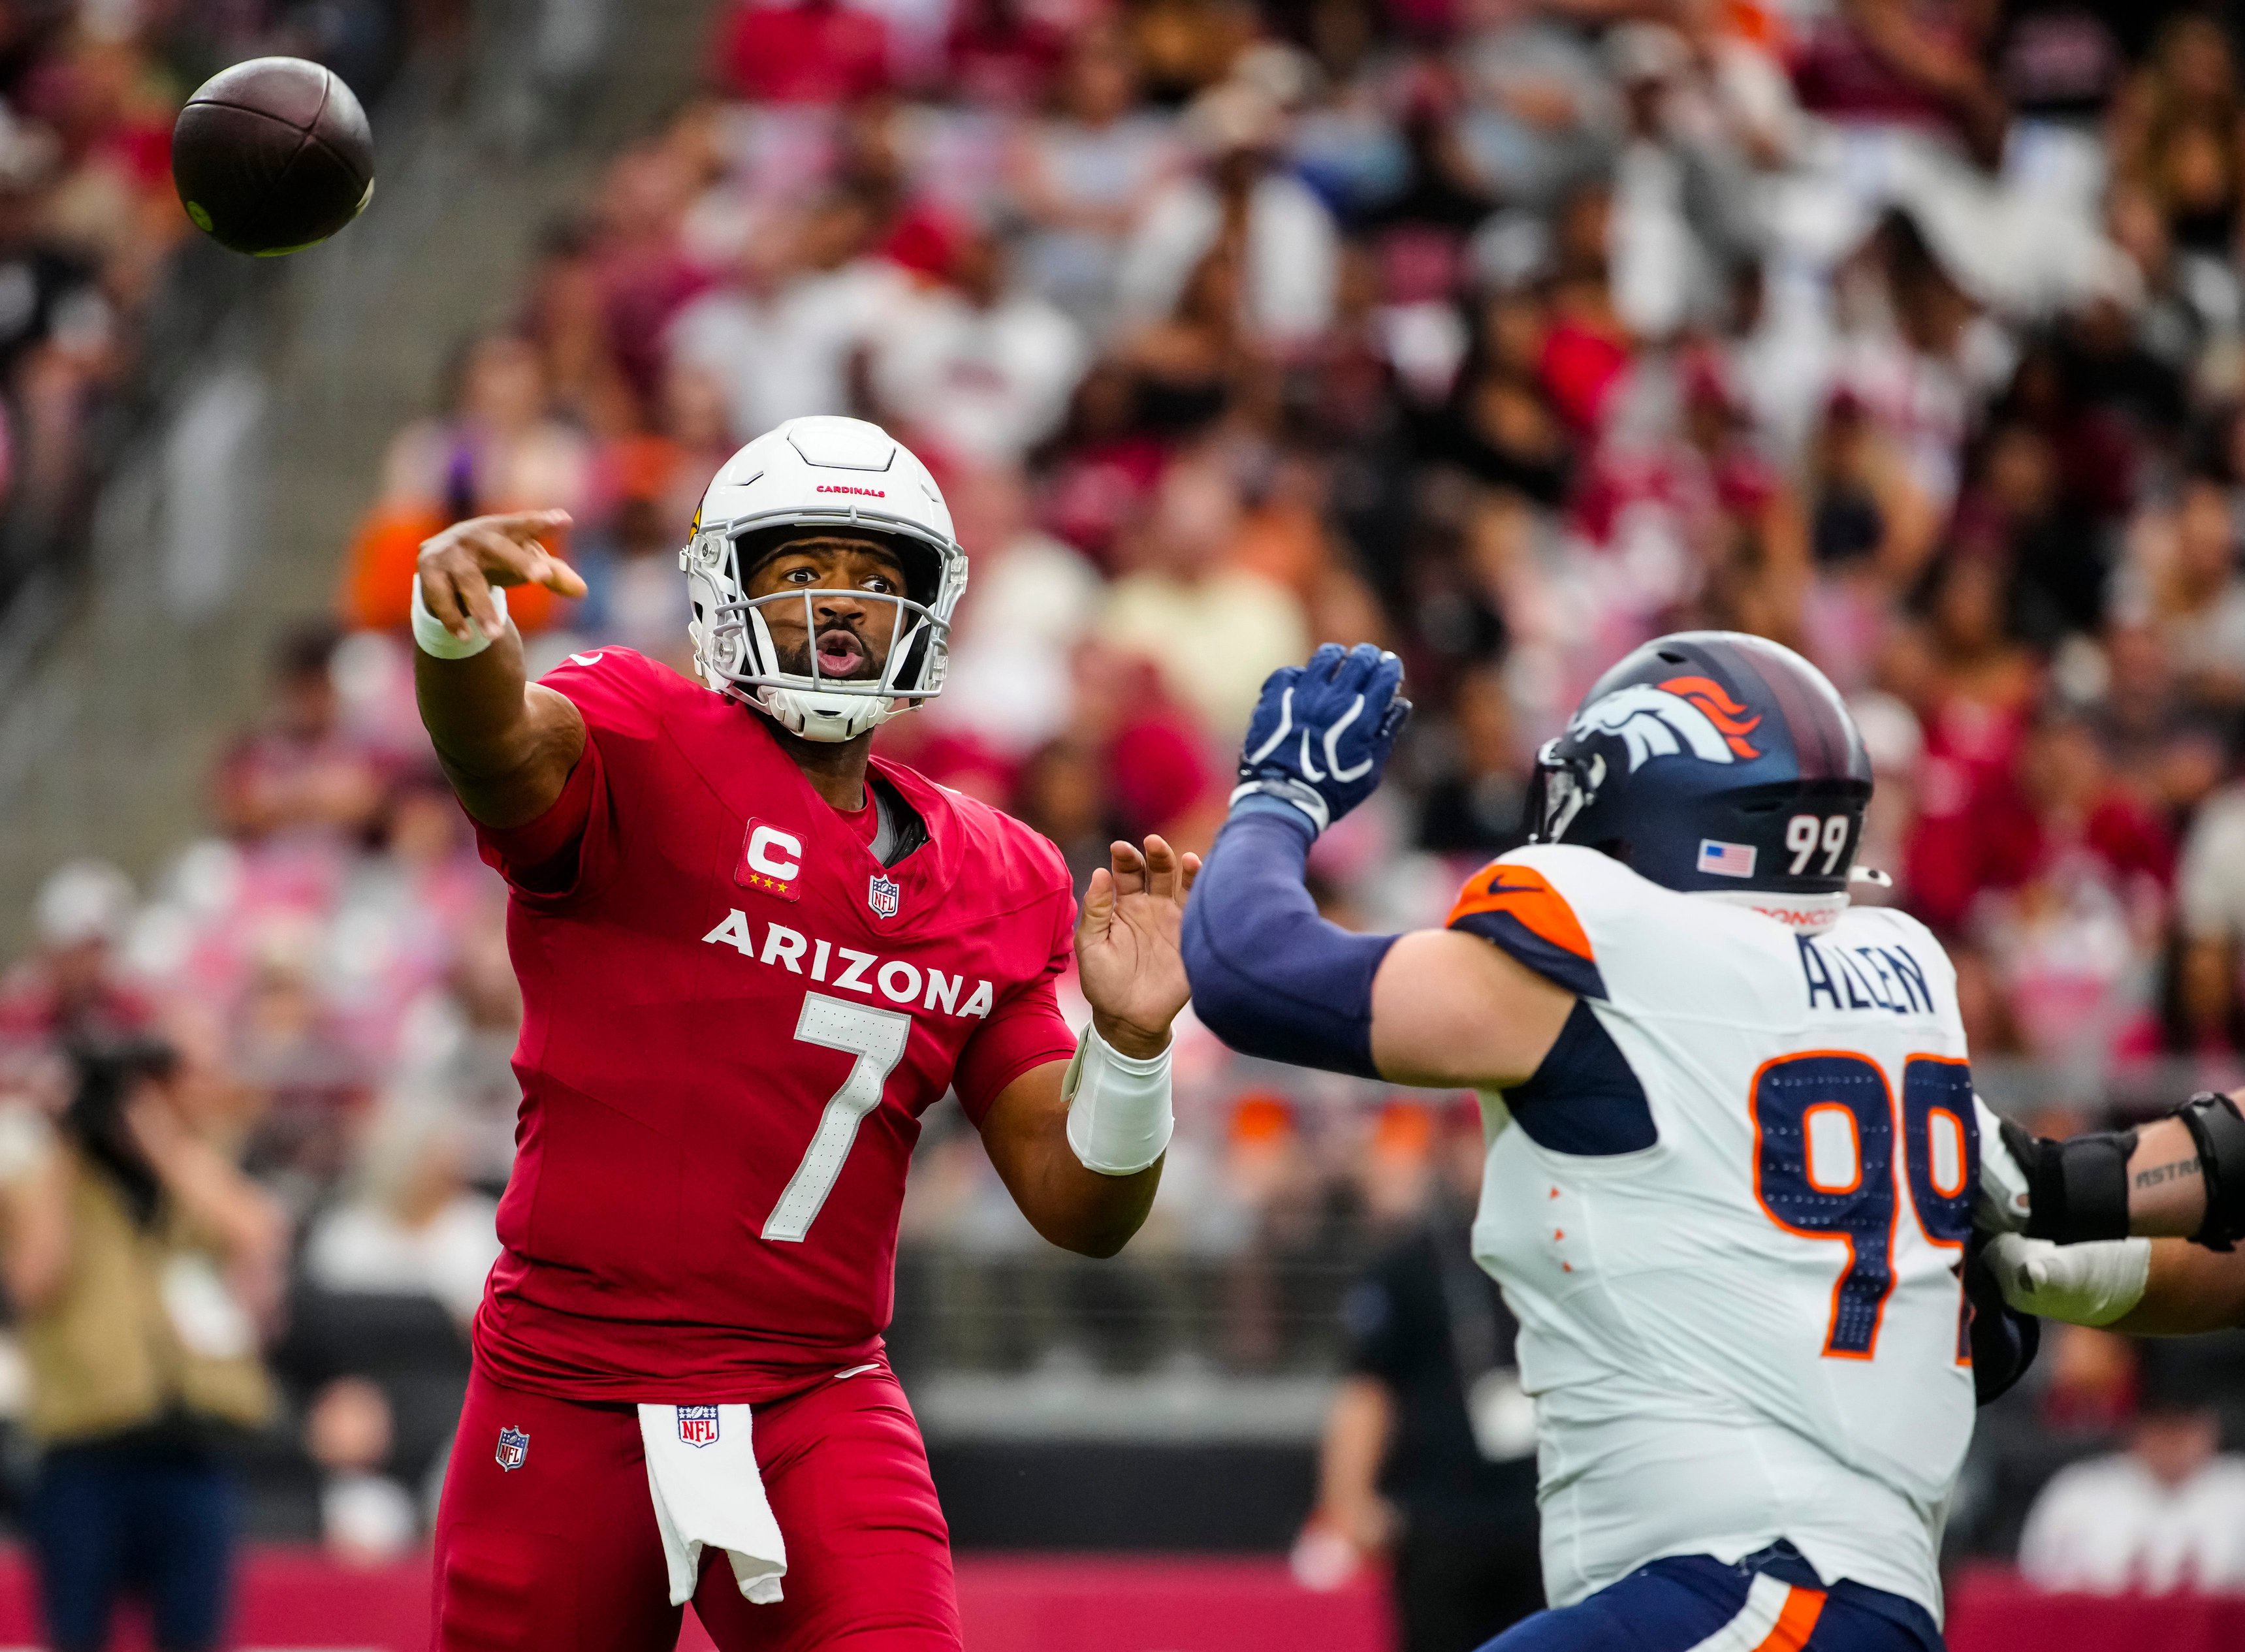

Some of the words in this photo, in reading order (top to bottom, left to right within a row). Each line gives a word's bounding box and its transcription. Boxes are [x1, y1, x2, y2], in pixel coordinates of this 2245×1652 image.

[816, 485, 885, 498] CARDINALS
[746, 825, 803, 882] C
[1786, 813, 1849, 875] 99
[874, 892, 893, 910] NFL
[701, 908, 993, 1019] ARIZONA
[1794, 932, 1935, 1014] ALLEN
[761, 990, 912, 1243] 7
[500, 1444, 519, 1463] NFL
[682, 1420, 714, 1442] NFL
